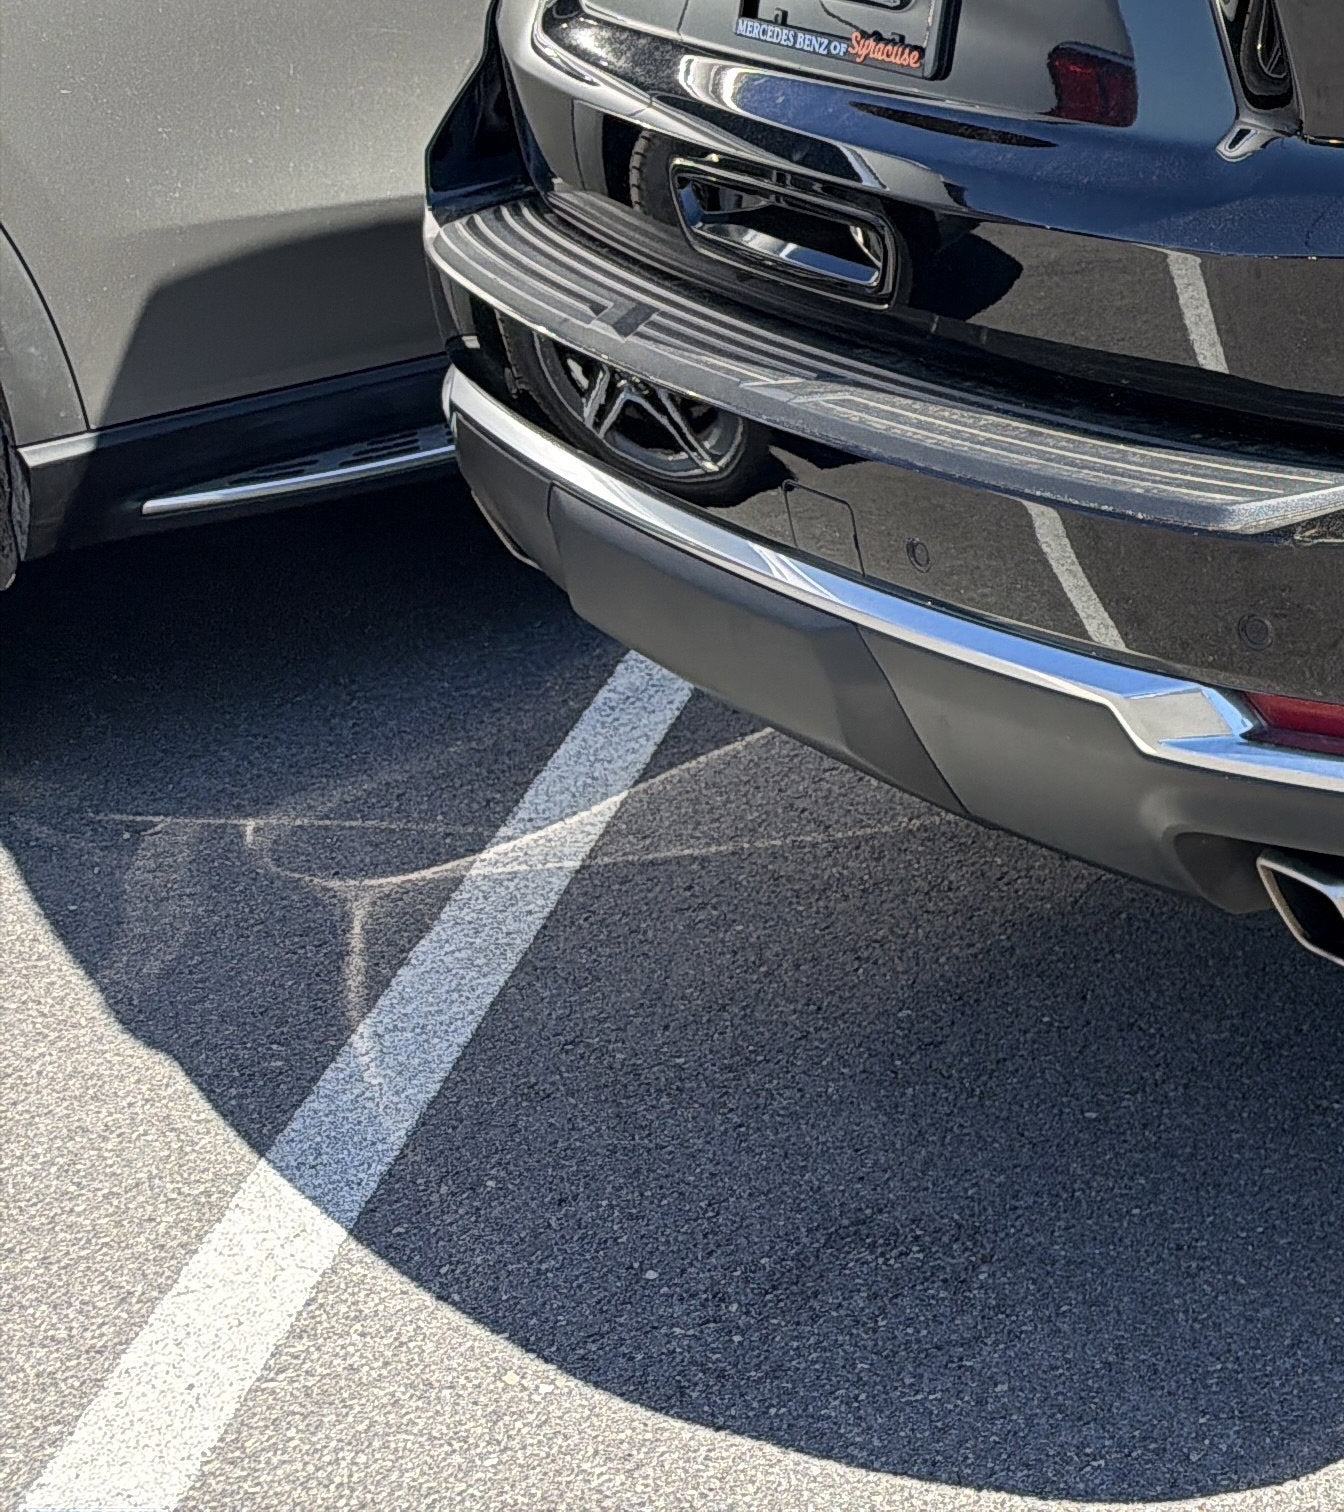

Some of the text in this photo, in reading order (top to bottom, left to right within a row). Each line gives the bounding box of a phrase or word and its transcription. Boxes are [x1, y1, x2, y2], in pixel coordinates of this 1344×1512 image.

[737, 19, 922, 68] MERCEDES BENZ OF Syracuse
